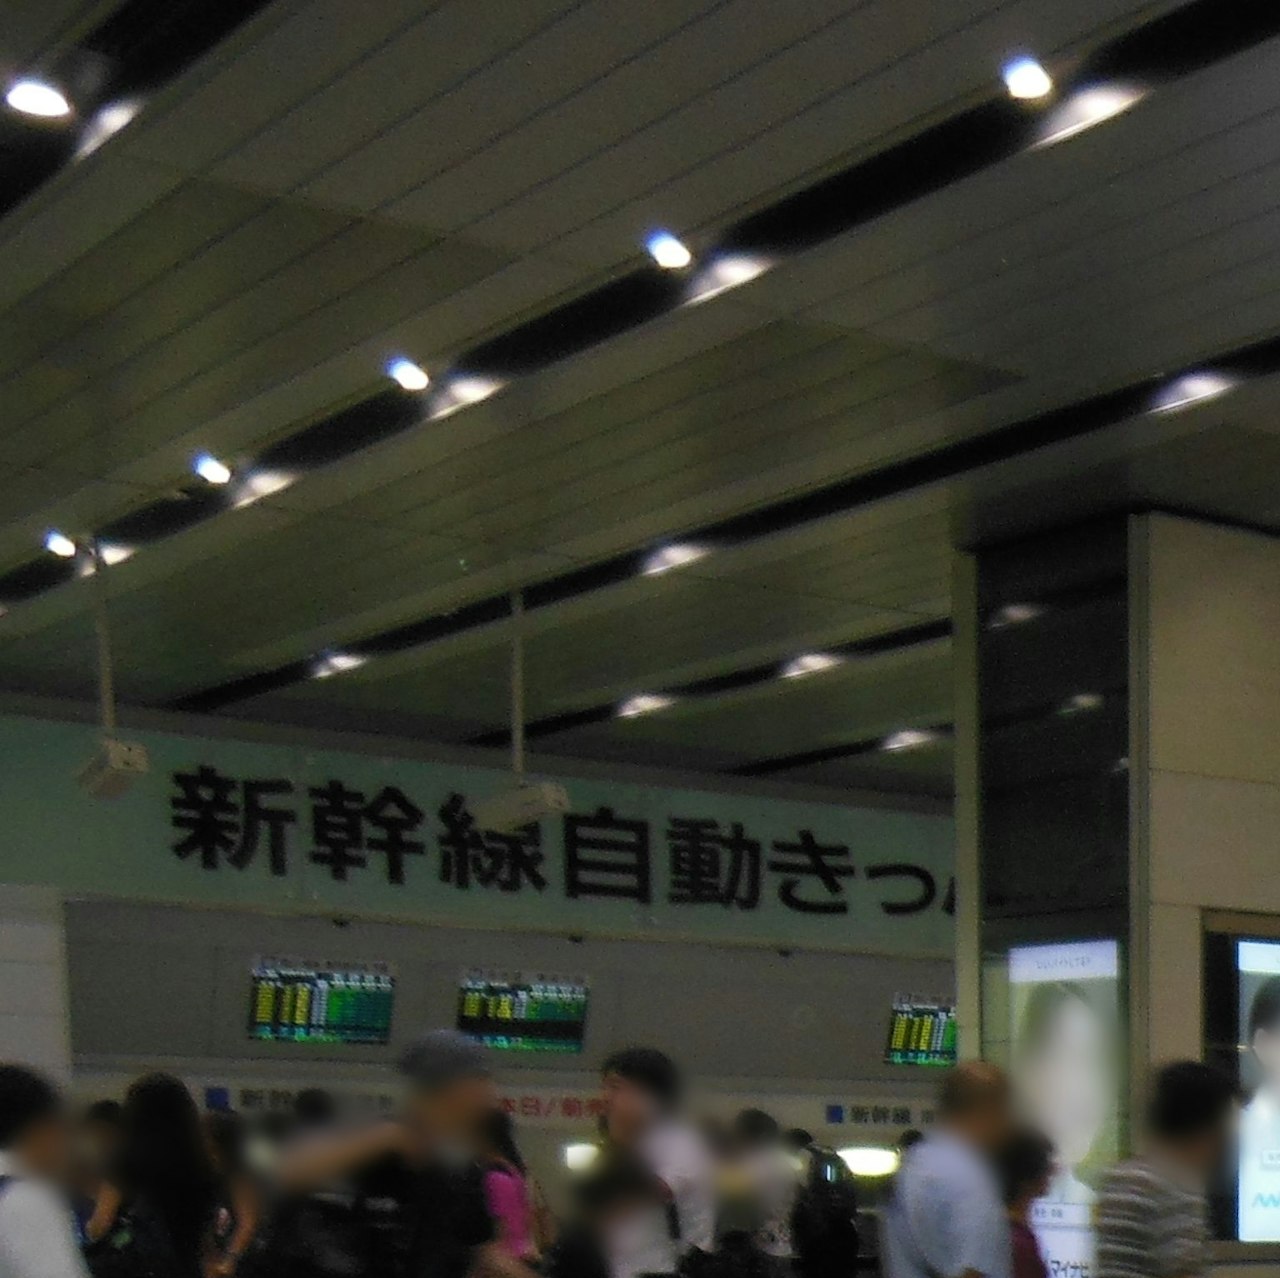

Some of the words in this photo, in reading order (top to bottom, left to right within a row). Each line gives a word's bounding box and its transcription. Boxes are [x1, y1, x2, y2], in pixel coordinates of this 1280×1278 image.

[170, 765, 957, 917] 新幹線自動きっ
